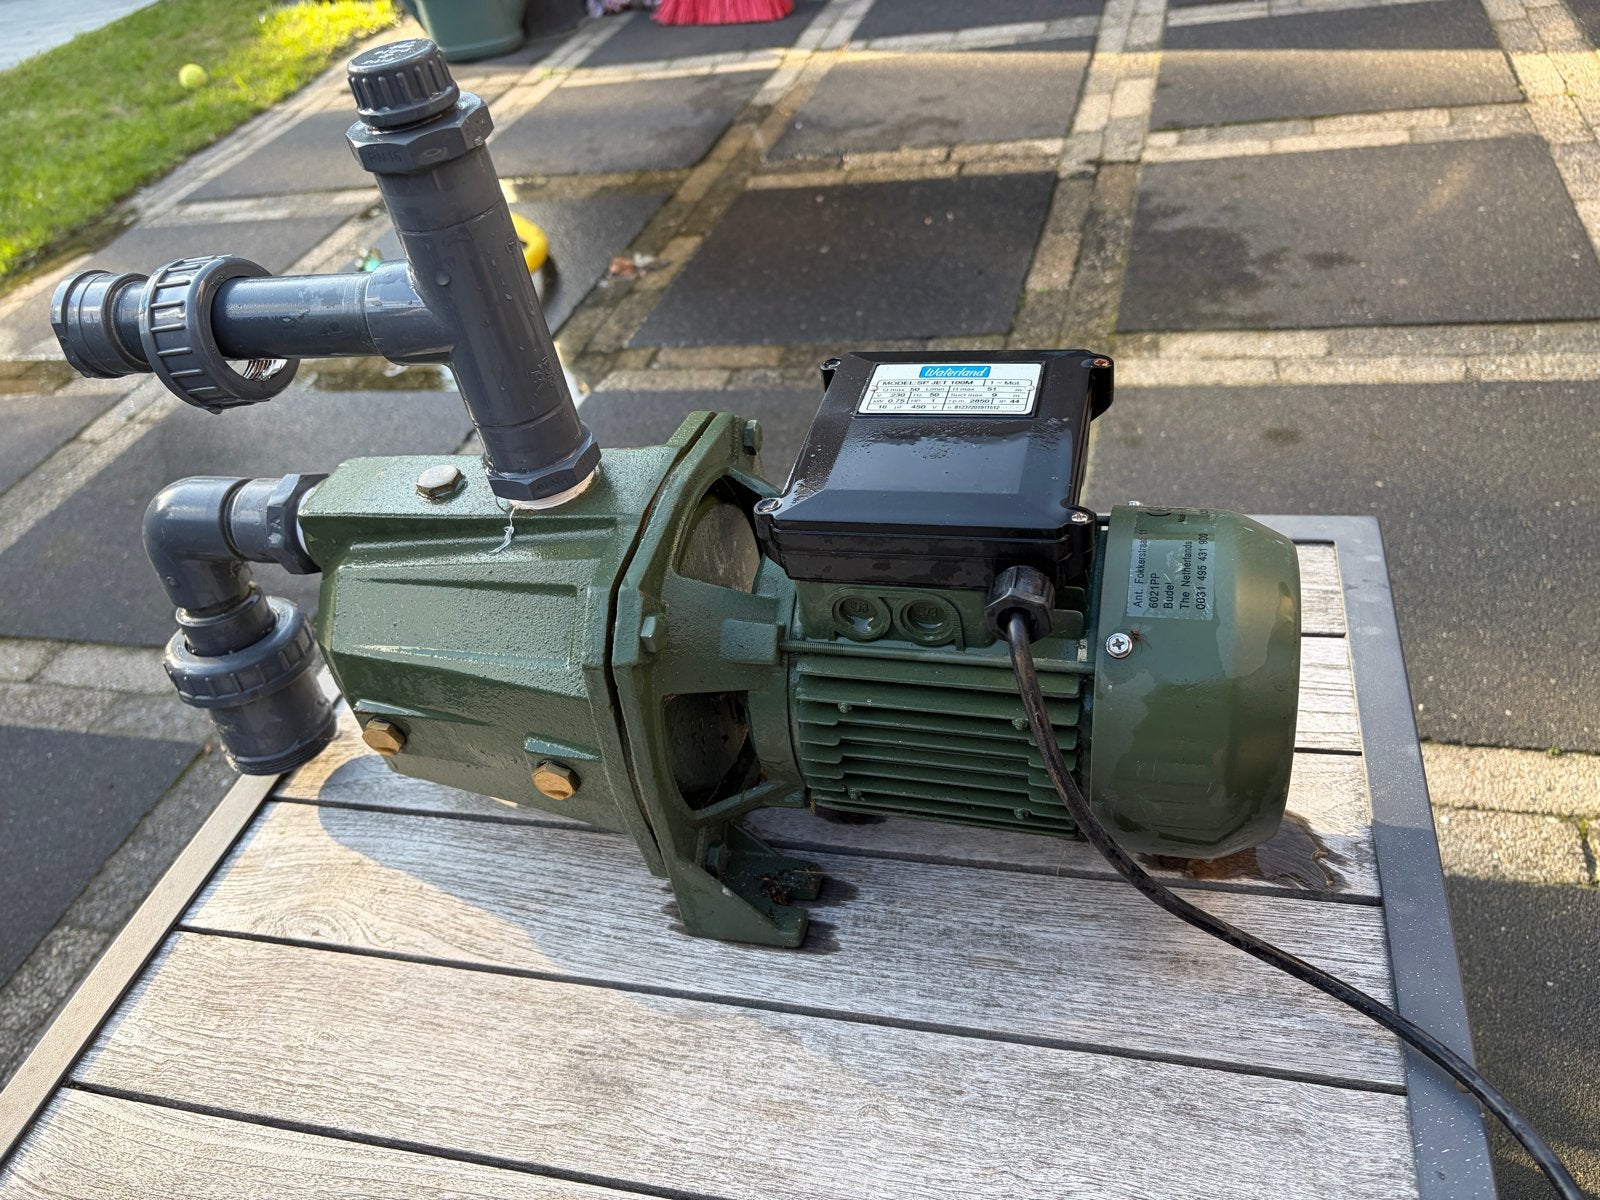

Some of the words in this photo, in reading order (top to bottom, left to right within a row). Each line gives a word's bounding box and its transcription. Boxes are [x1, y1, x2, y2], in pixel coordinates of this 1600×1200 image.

[924, 366, 988, 377] Waterland
[1180, 540, 1193, 587] Netherlands
[1198, 548, 1208, 561] 431
[1197, 565, 1207, 581] 495
[1133, 589, 1144, 608] Ant.
[1148, 572, 1160, 609] 6021PP
[1163, 582, 1175, 609] Budel
[1195, 586, 1207, 610] 0031
[1179, 591, 1190, 610] The
